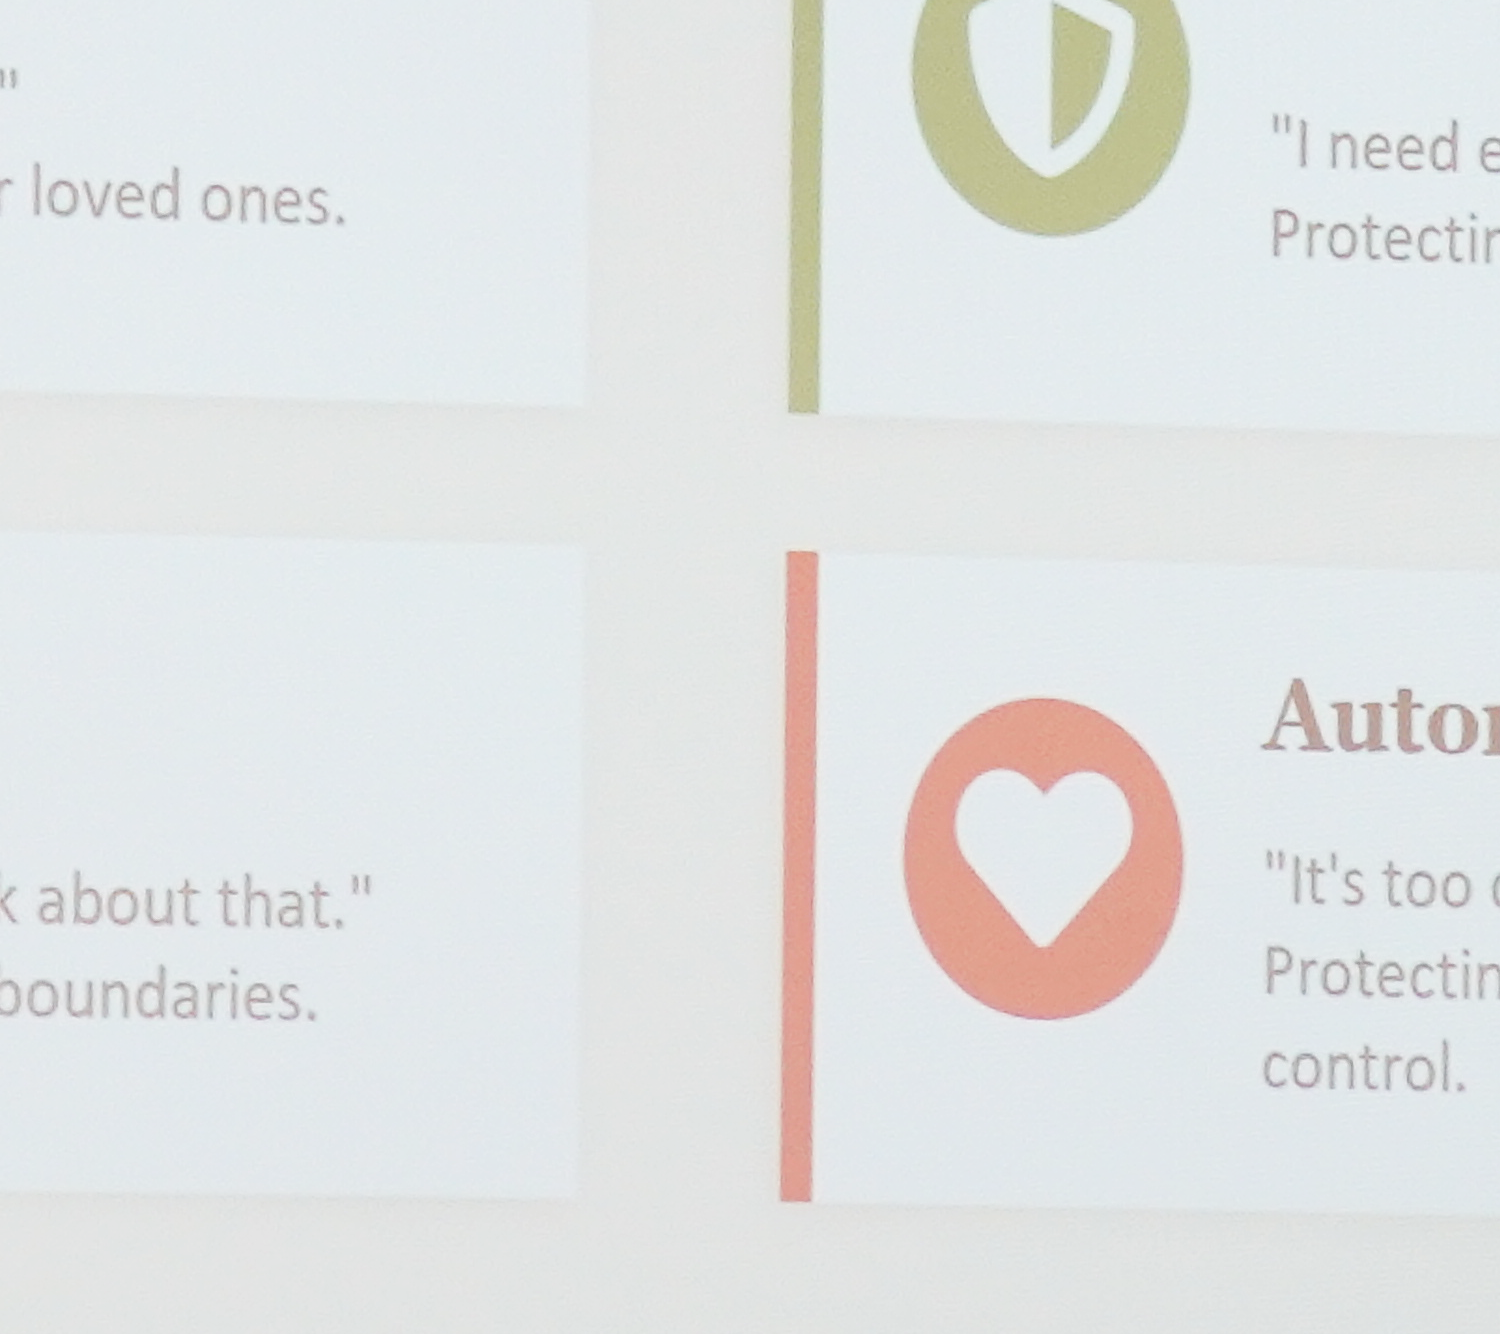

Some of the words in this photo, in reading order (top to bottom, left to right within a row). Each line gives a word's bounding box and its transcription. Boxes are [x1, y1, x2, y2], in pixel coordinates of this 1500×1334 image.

[1272, 113, 1309, 170] "I
[1330, 118, 1459, 174] need
[32, 161, 181, 221] loved
[200, 183, 347, 226] ones.
[36, 869, 201, 928] about
[216, 872, 373, 930] that."
[1265, 849, 1366, 907] "It's
[1381, 860, 1473, 910] too
[1262, 1038, 1468, 1094] control.
